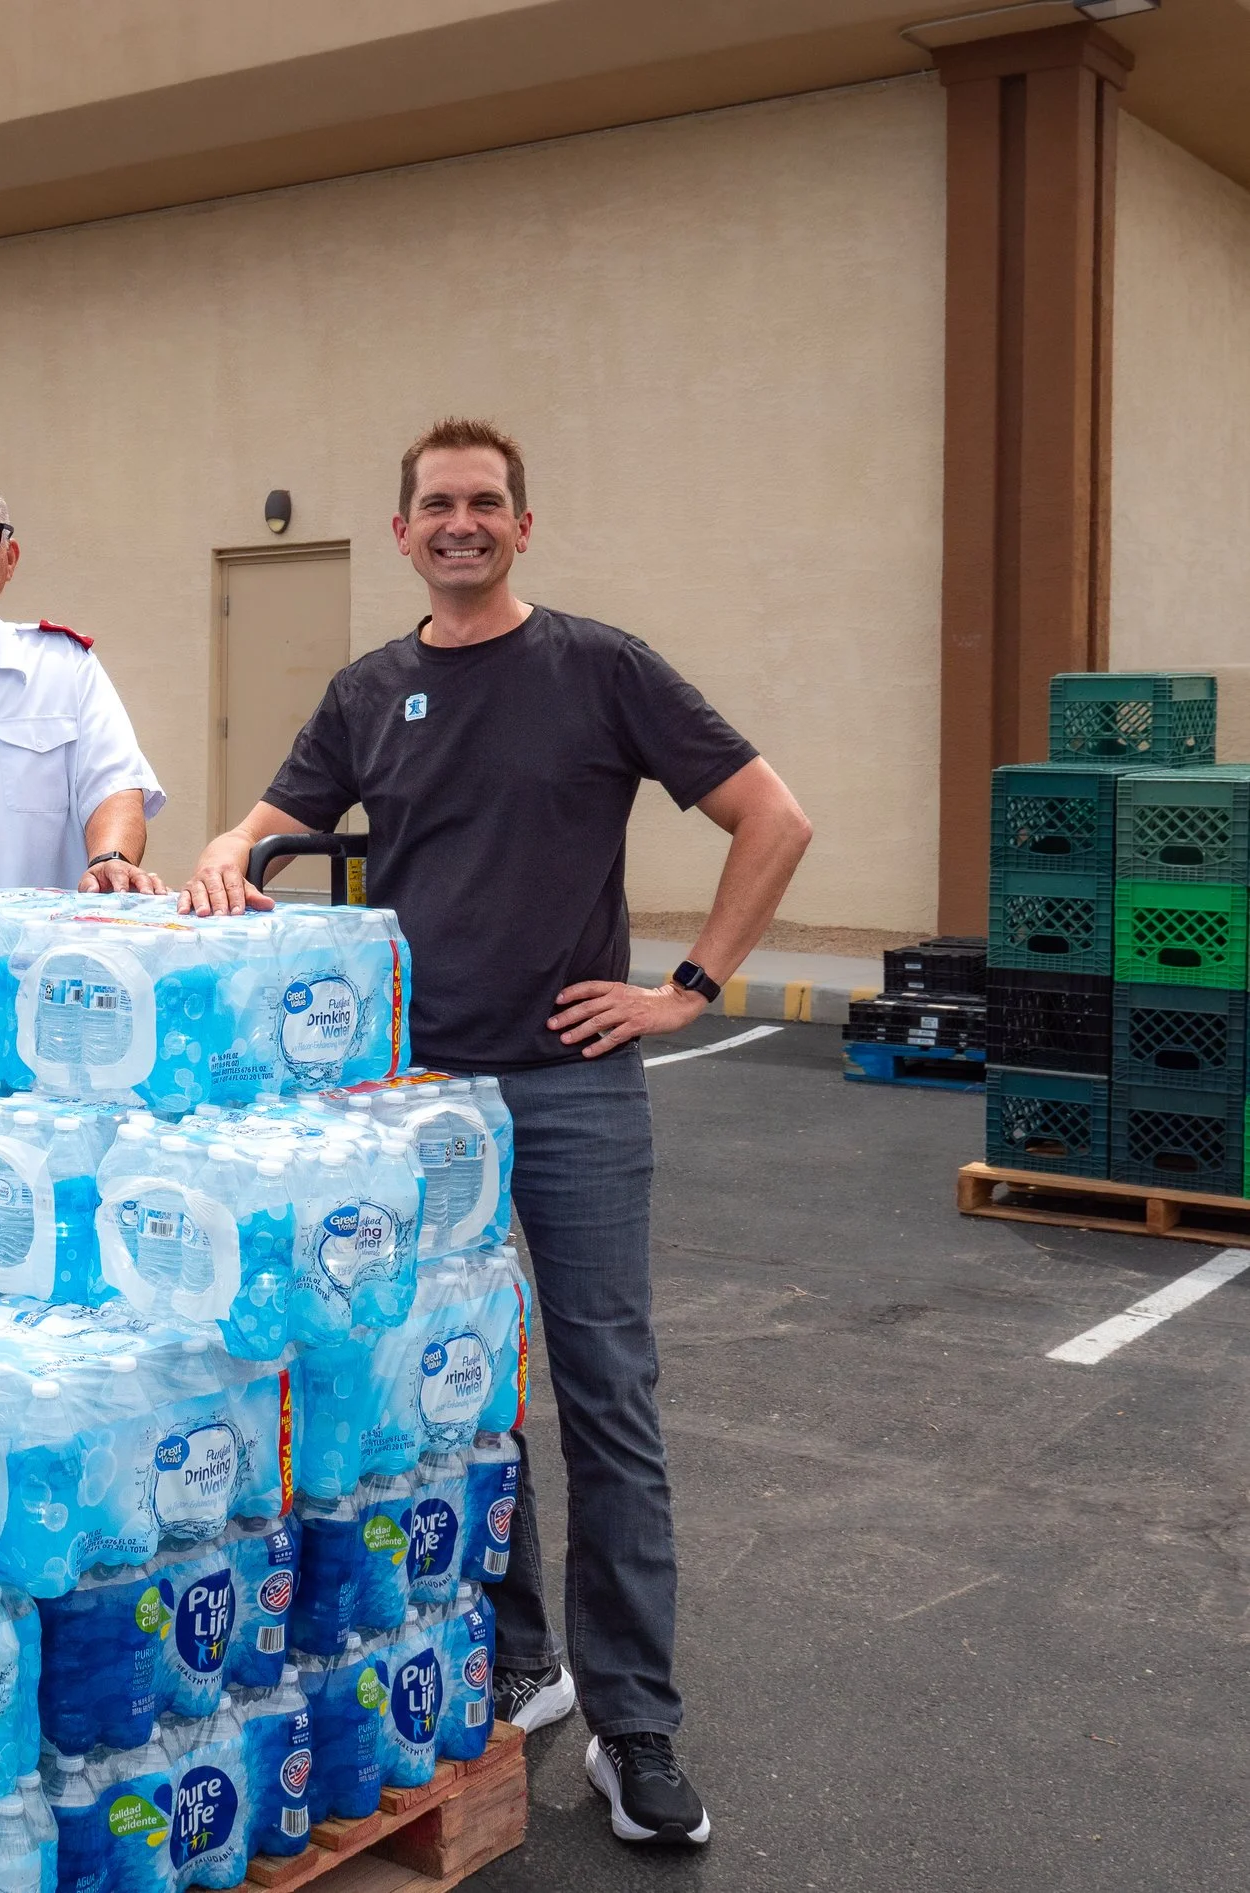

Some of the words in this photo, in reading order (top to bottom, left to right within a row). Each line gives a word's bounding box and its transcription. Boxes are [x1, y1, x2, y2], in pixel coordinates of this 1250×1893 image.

[286, 987, 307, 1003] Great
[290, 997, 307, 1008] Value
[307, 1010, 351, 1027] Drinking
[322, 1024, 351, 1039] Water
[393, 1007, 401, 1055] PACK
[330, 1214, 358, 1226] Great
[423, 1349, 442, 1364] Great
[427, 1358, 442, 1370] Value
[455, 1379, 483, 1398] Water
[157, 1442, 183, 1459] Great
[161, 1453, 183, 1465] Value
[184, 1457, 232, 1486] Drinking
[282, 1444, 294, 1500] PACK
[505, 1465, 517, 1479] 35
[200, 1474, 231, 1497] Water
[412, 1510, 449, 1540] Pure
[130, 1545, 149, 1553] TOTAL
[272, 1532, 289, 1549] 35
[469, 1611, 483, 1626] 35
[176, 1663, 209, 1686] HEALTHY
[294, 1712, 309, 1731] 35
[394, 1736, 424, 1757] HEALTHY
[178, 1777, 223, 1817] Pure
[109, 1802, 142, 1823] Calidad
[180, 1802, 215, 1838] Life
[117, 1816, 158, 1834] evidente
